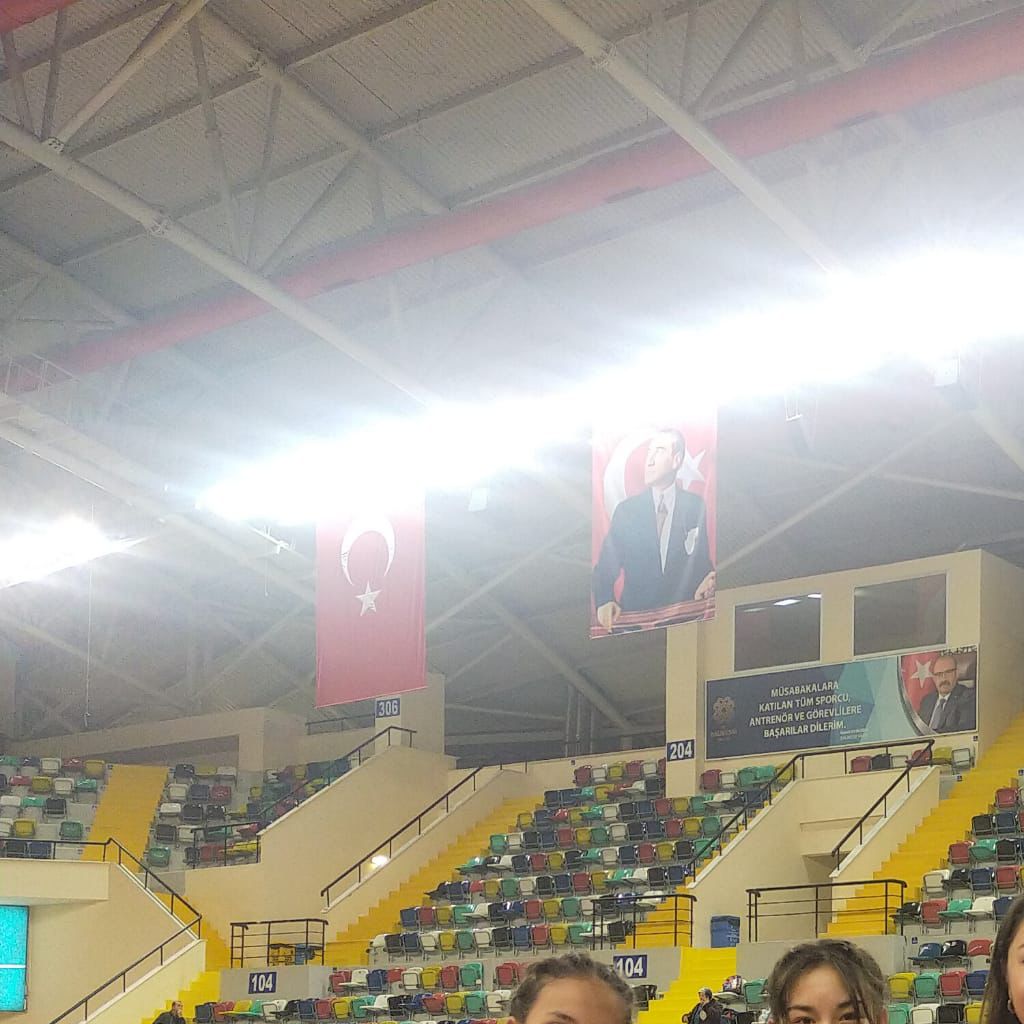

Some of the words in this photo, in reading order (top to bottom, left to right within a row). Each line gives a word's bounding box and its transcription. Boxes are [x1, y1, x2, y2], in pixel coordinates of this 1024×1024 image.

[771, 681, 839, 698] MÜSABAKALARA
[378, 700, 398, 716] 306
[759, 700, 794, 713] KATILAN
[796, 697, 813, 708] TÜM
[750, 711, 794, 727] ANTRENÖR
[794, 711, 806, 721] VE
[806, 704, 862, 720] GÖREVLİLERE
[764, 723, 809, 740] BAŞARILAR
[810, 719, 847, 733] DİLERİM.
[670, 741, 692, 760] 204
[616, 956, 644, 978] 104
[252, 974, 273, 992] 104
